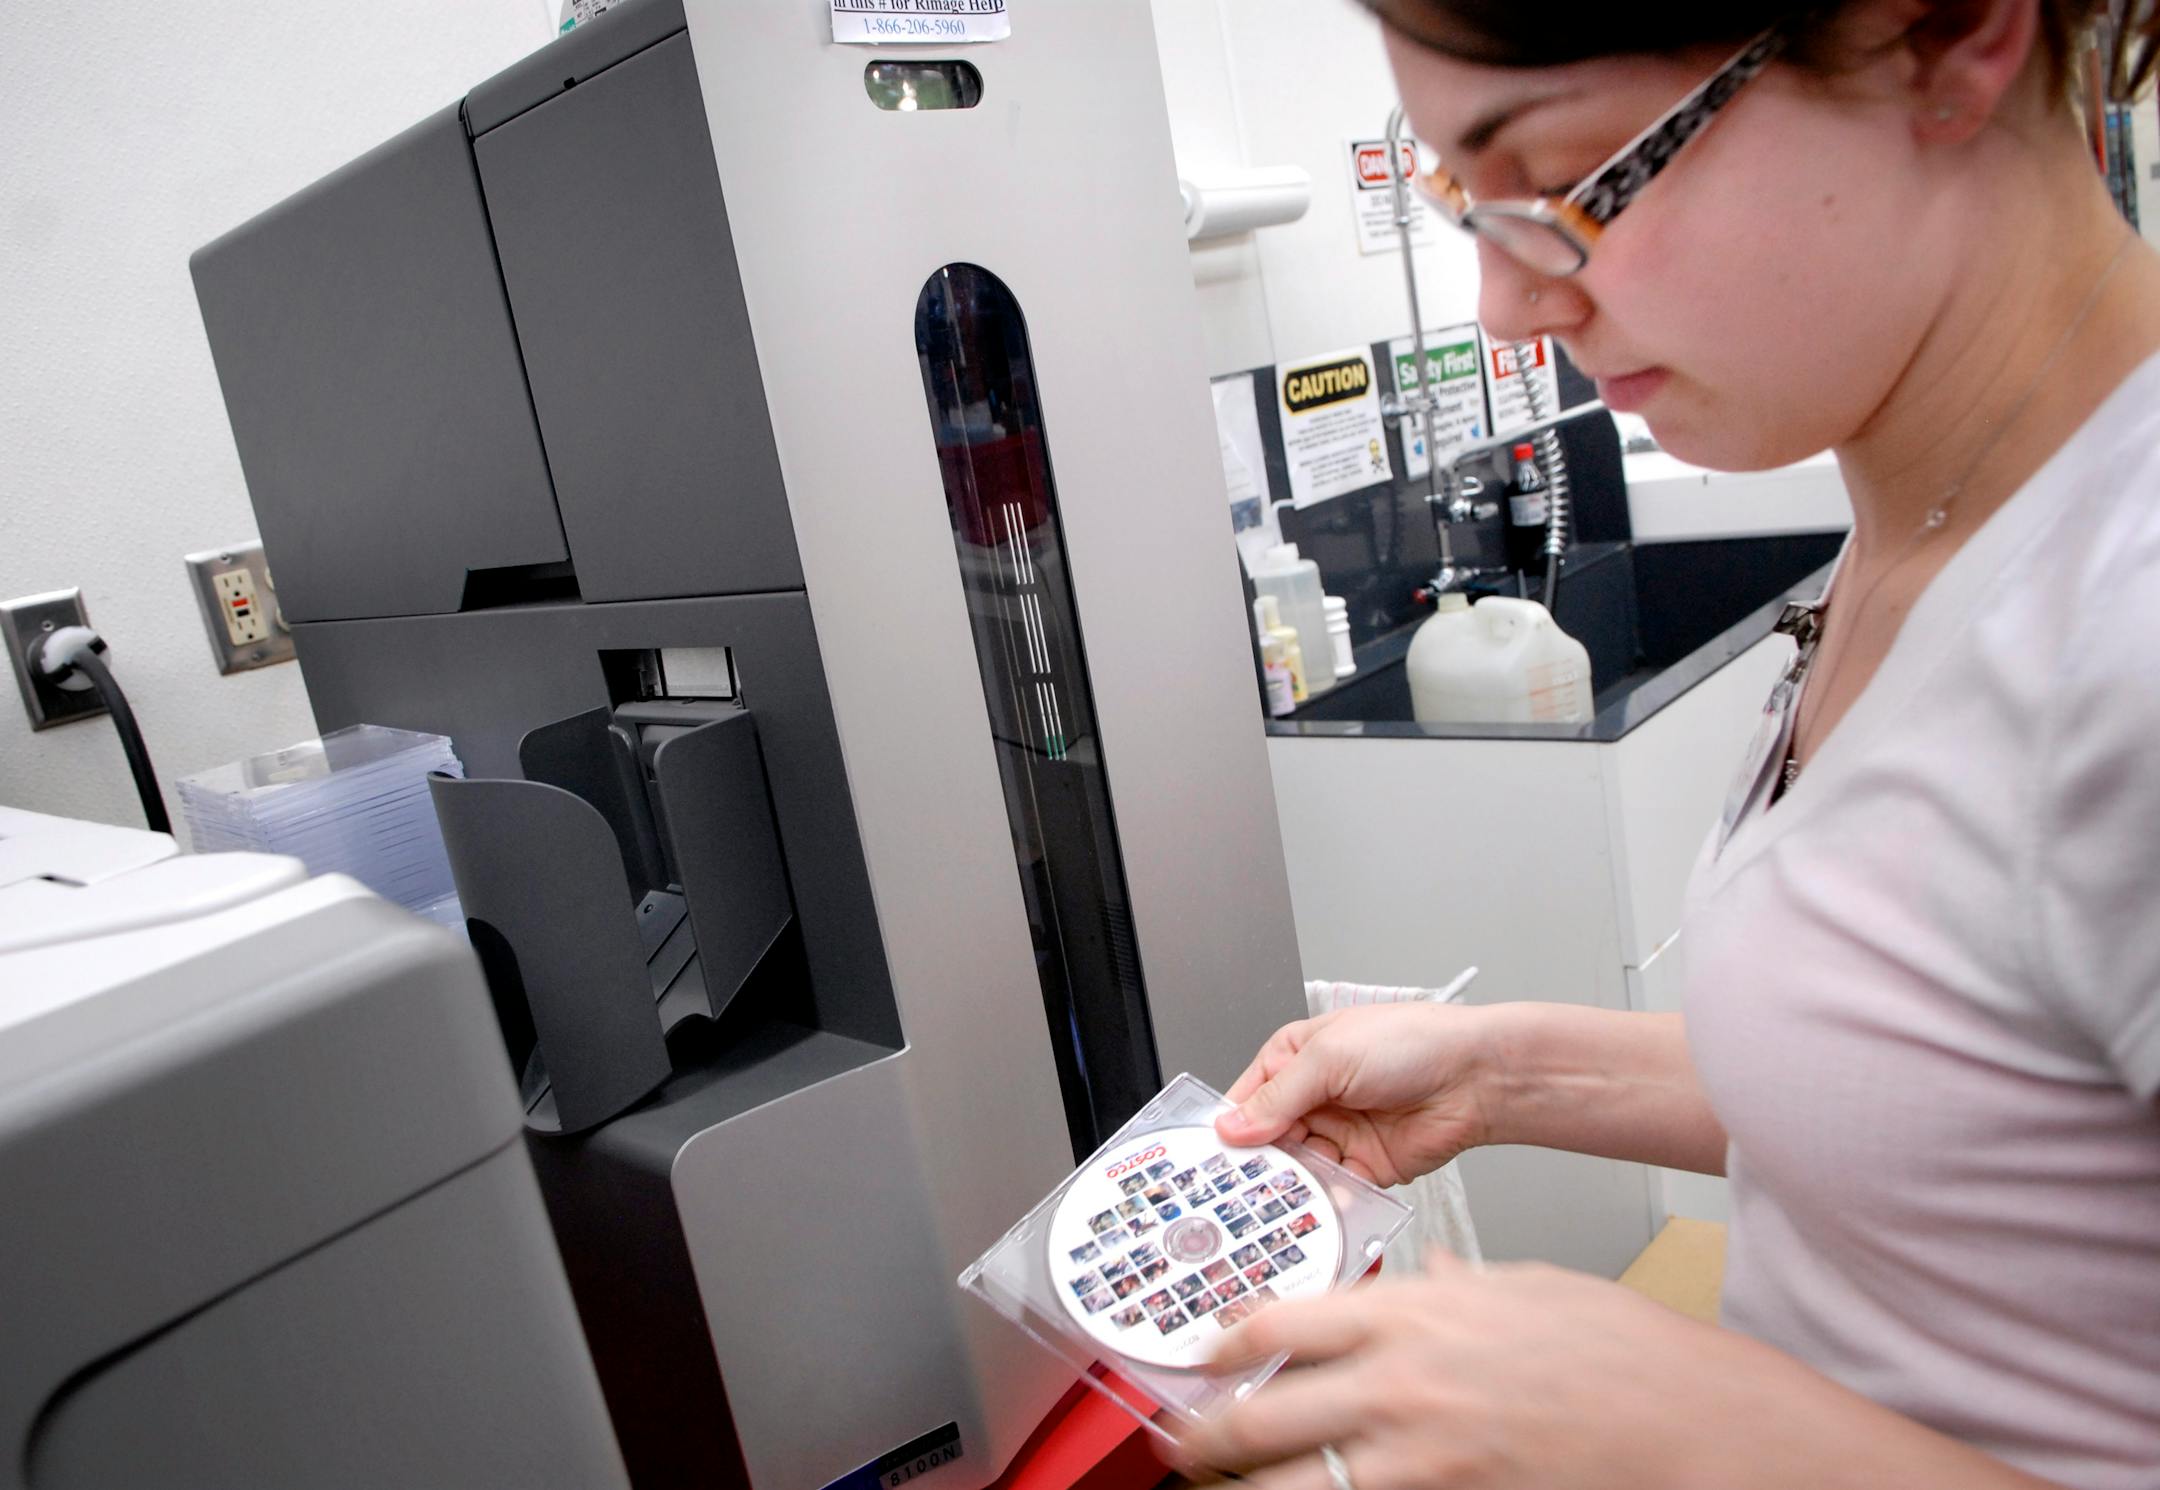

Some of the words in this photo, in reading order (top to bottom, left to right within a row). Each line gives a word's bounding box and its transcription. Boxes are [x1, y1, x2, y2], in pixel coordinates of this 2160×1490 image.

[850, 0, 876, 9] this
[891, 0, 910, 10] for
[914, 0, 965, 14] Rimage
[969, 0, 1003, 13] Help
[864, 17, 967, 35] 1-866-206-5960
[1443, 348, 1475, 375] First
[1288, 363, 1367, 403] CAUTION
[1106, 1146, 1167, 1178] COSTCO
[890, 1444, 956, 1488] 8100N
